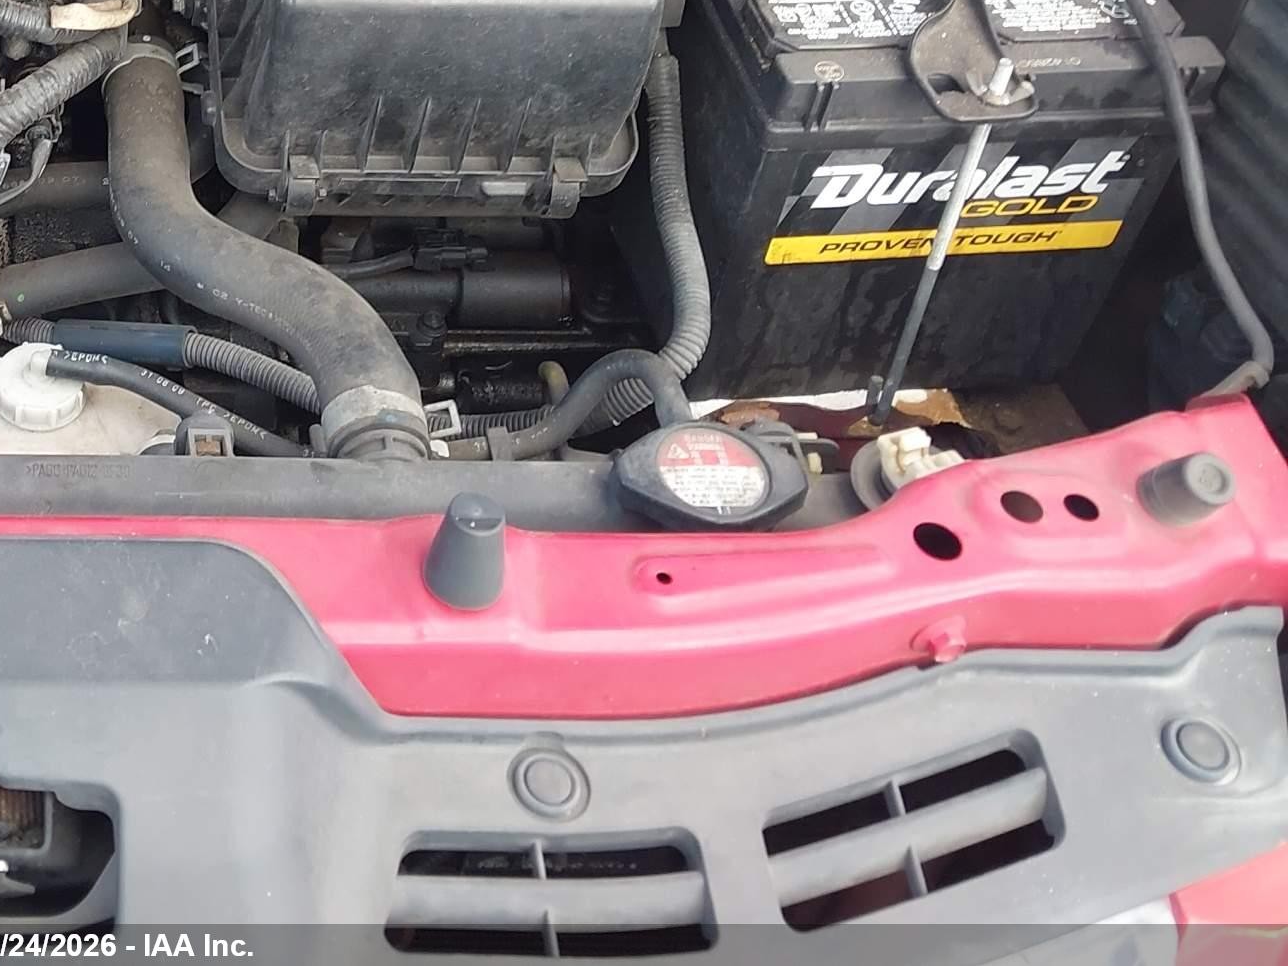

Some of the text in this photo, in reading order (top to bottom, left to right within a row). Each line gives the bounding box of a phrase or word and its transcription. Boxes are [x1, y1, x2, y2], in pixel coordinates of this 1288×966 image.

[810, 151, 1127, 210] Duralast
[960, 195, 1100, 219] GOLD
[818, 231, 1057, 255] PROVEN TOUGH
